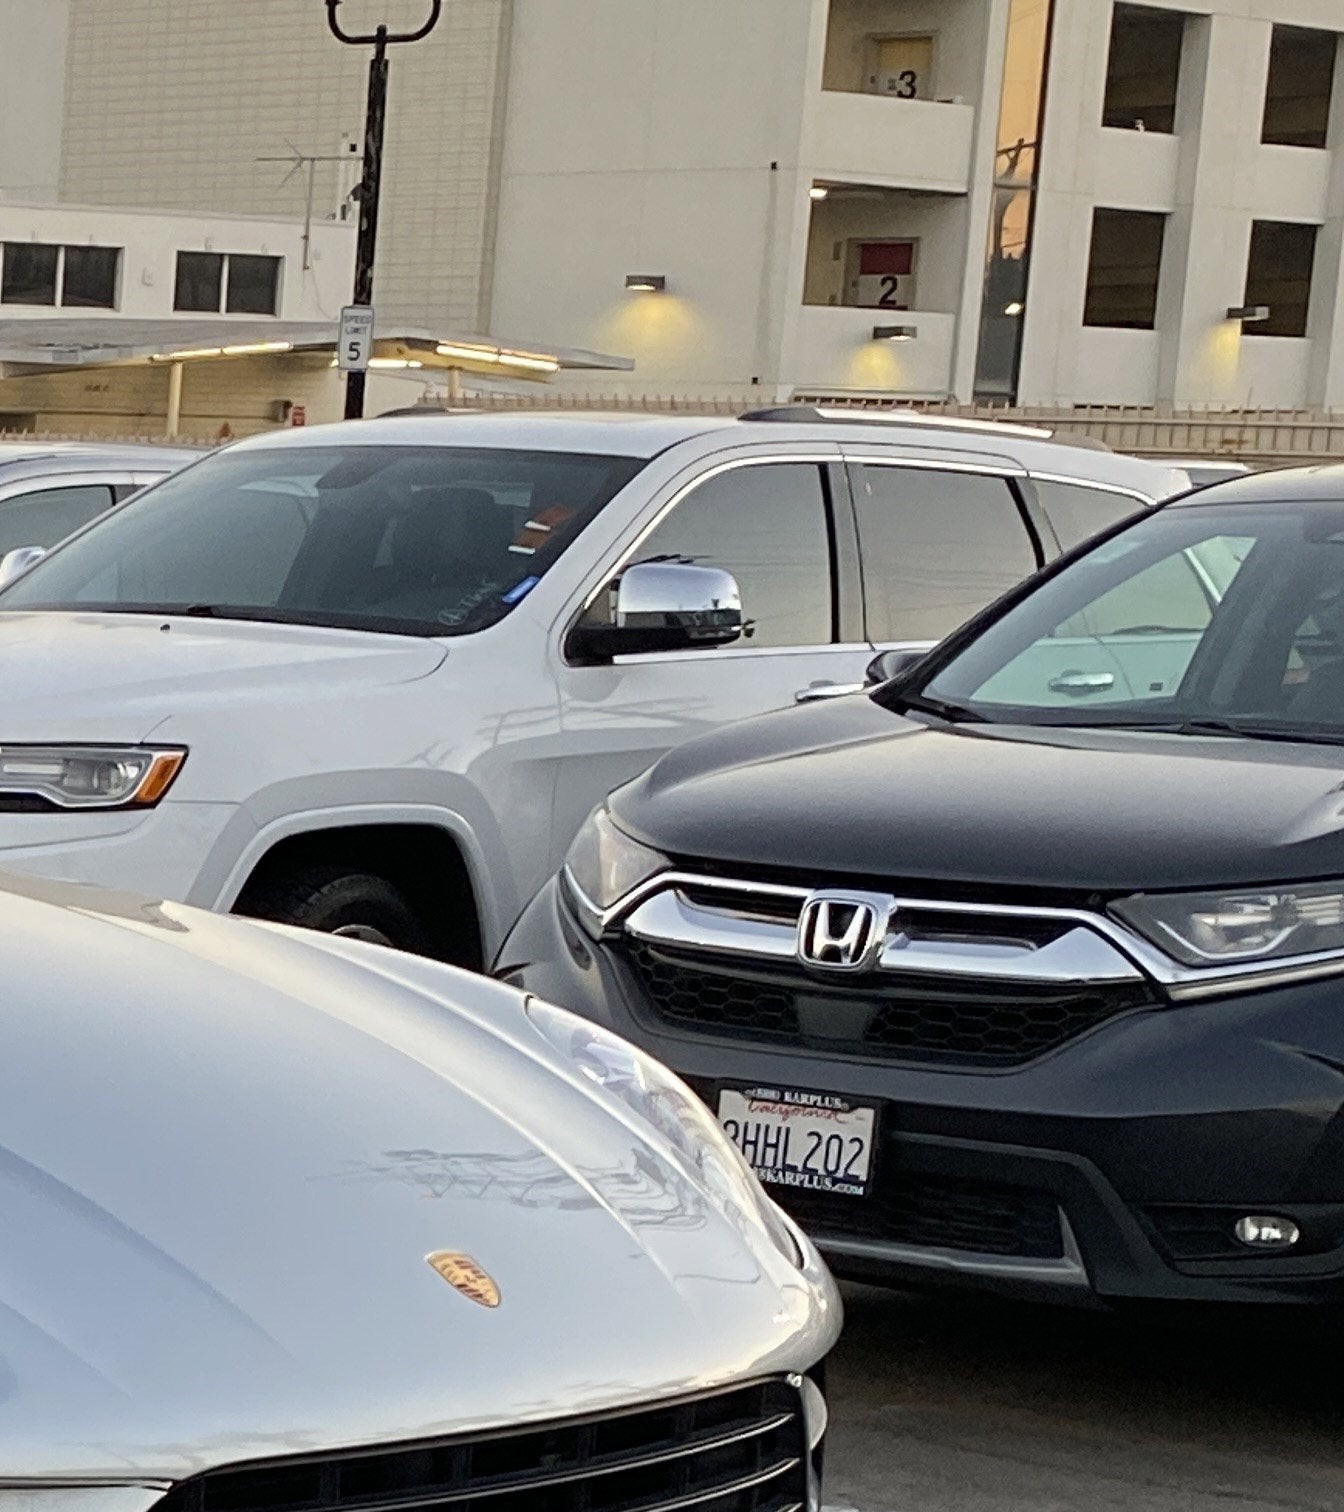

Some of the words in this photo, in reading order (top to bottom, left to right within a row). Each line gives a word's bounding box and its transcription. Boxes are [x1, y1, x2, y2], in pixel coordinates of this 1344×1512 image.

[896, 70, 918, 100] 3
[878, 275, 899, 306] 2
[347, 341, 361, 361] 5
[783, 1091, 842, 1108] KARPLUS
